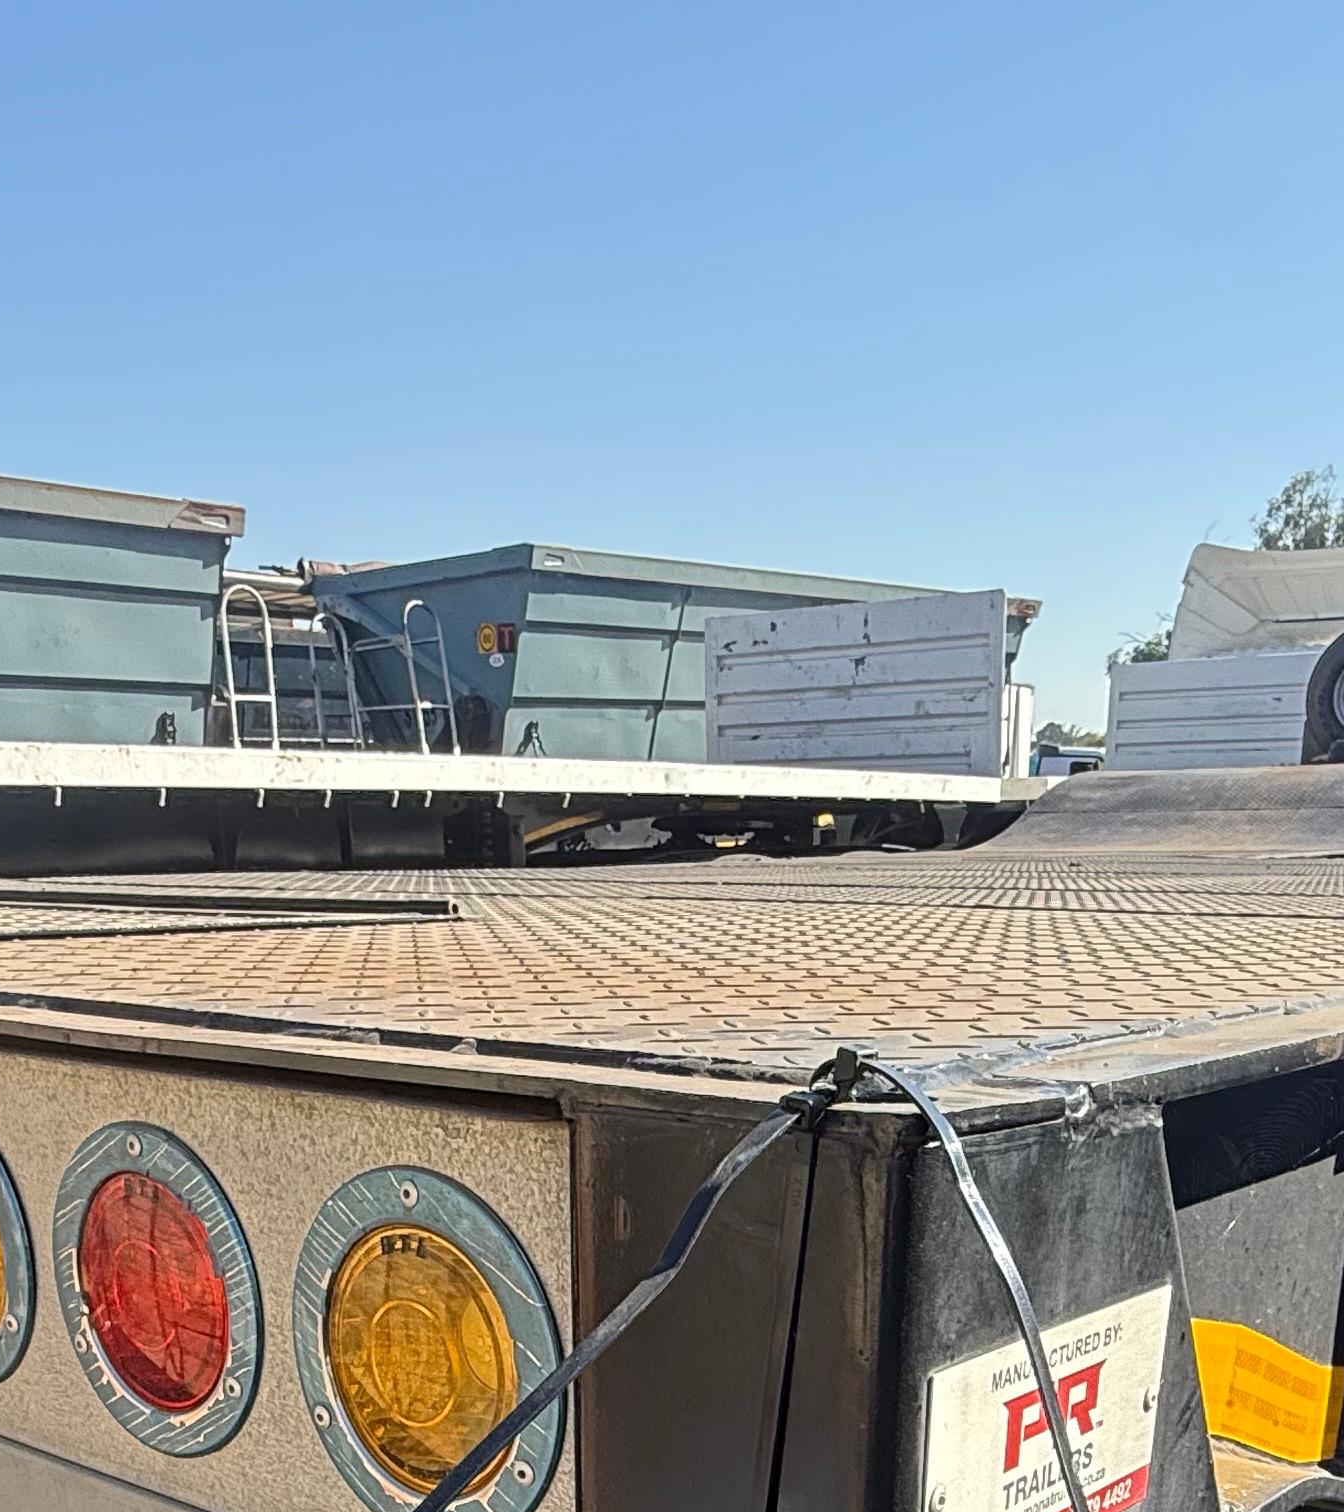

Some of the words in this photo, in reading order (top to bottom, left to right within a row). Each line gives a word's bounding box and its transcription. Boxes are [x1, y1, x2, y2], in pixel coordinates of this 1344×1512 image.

[990, 1331, 1101, 1393] MANUCTURED
[1103, 1322, 1123, 1347] BY:
[1002, 1442, 1093, 1510] TRAILRS
[1102, 1479, 1133, 1510] 4492
